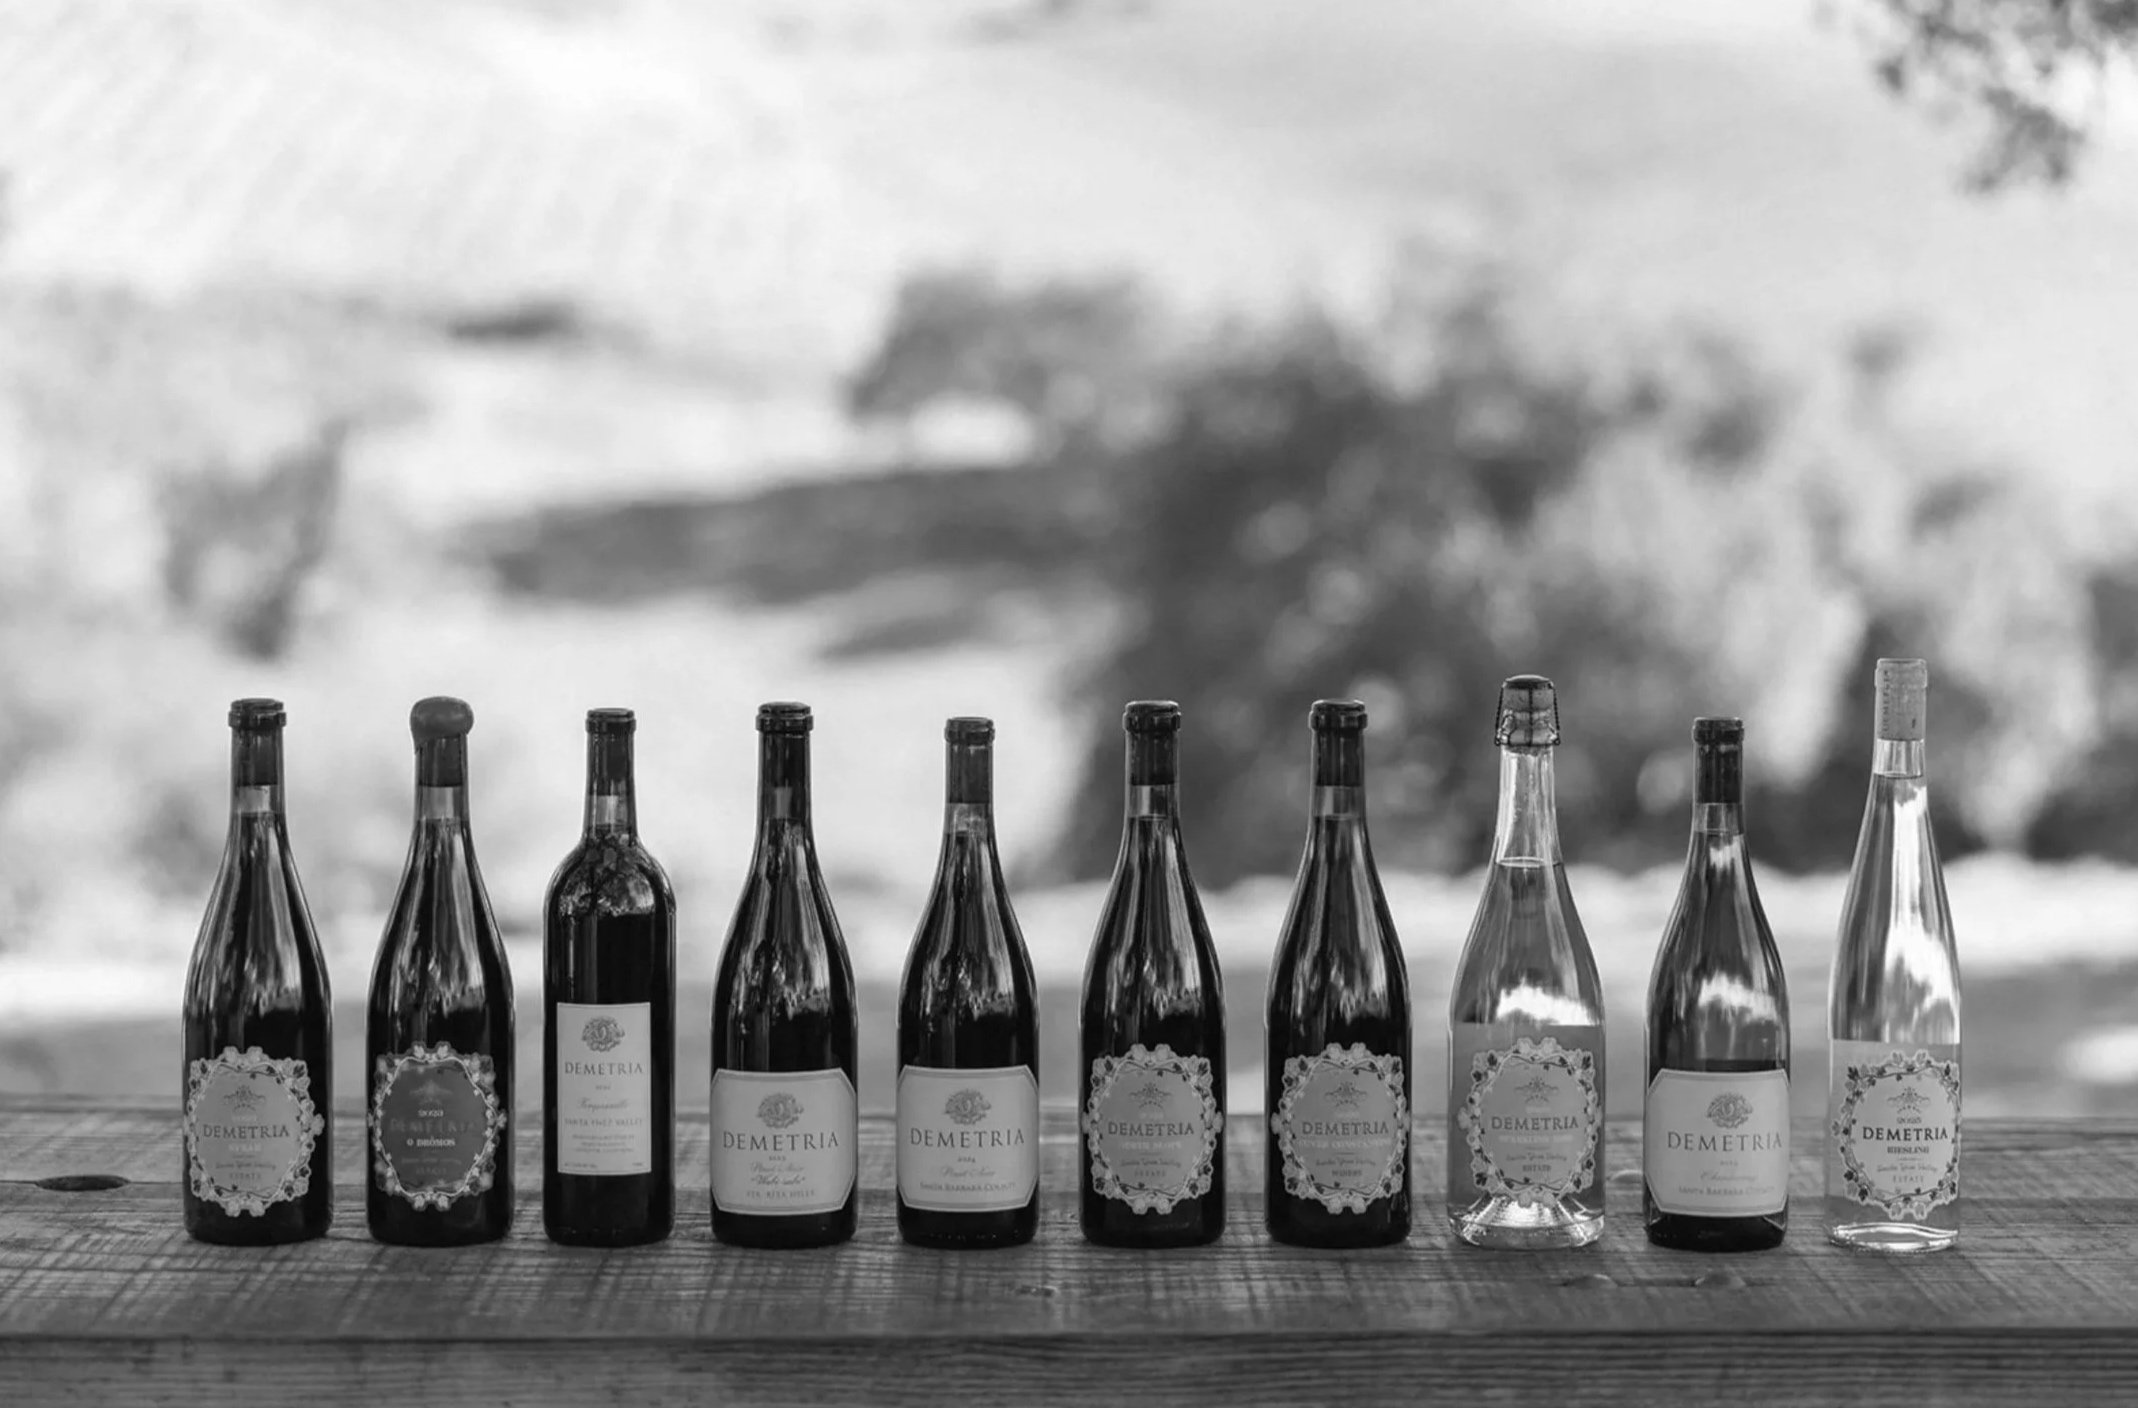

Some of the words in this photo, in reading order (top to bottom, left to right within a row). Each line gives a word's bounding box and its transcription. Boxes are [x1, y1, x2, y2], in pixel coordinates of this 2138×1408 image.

[564, 1061, 644, 1076] DEMETRIA
[1108, 1122, 1195, 1137] DEMETRIA
[1302, 1121, 1389, 1136] DEMETRIA
[1491, 1116, 1579, 1131] DEMETRIA
[203, 1124, 290, 1139] DEMETRIA
[910, 1128, 1025, 1148] DEMETRIA
[1862, 1126, 1948, 1141] DEMETRIA
[723, 1131, 839, 1152] DEMETRIA
[1667, 1131, 1782, 1152] DEMETRIA
